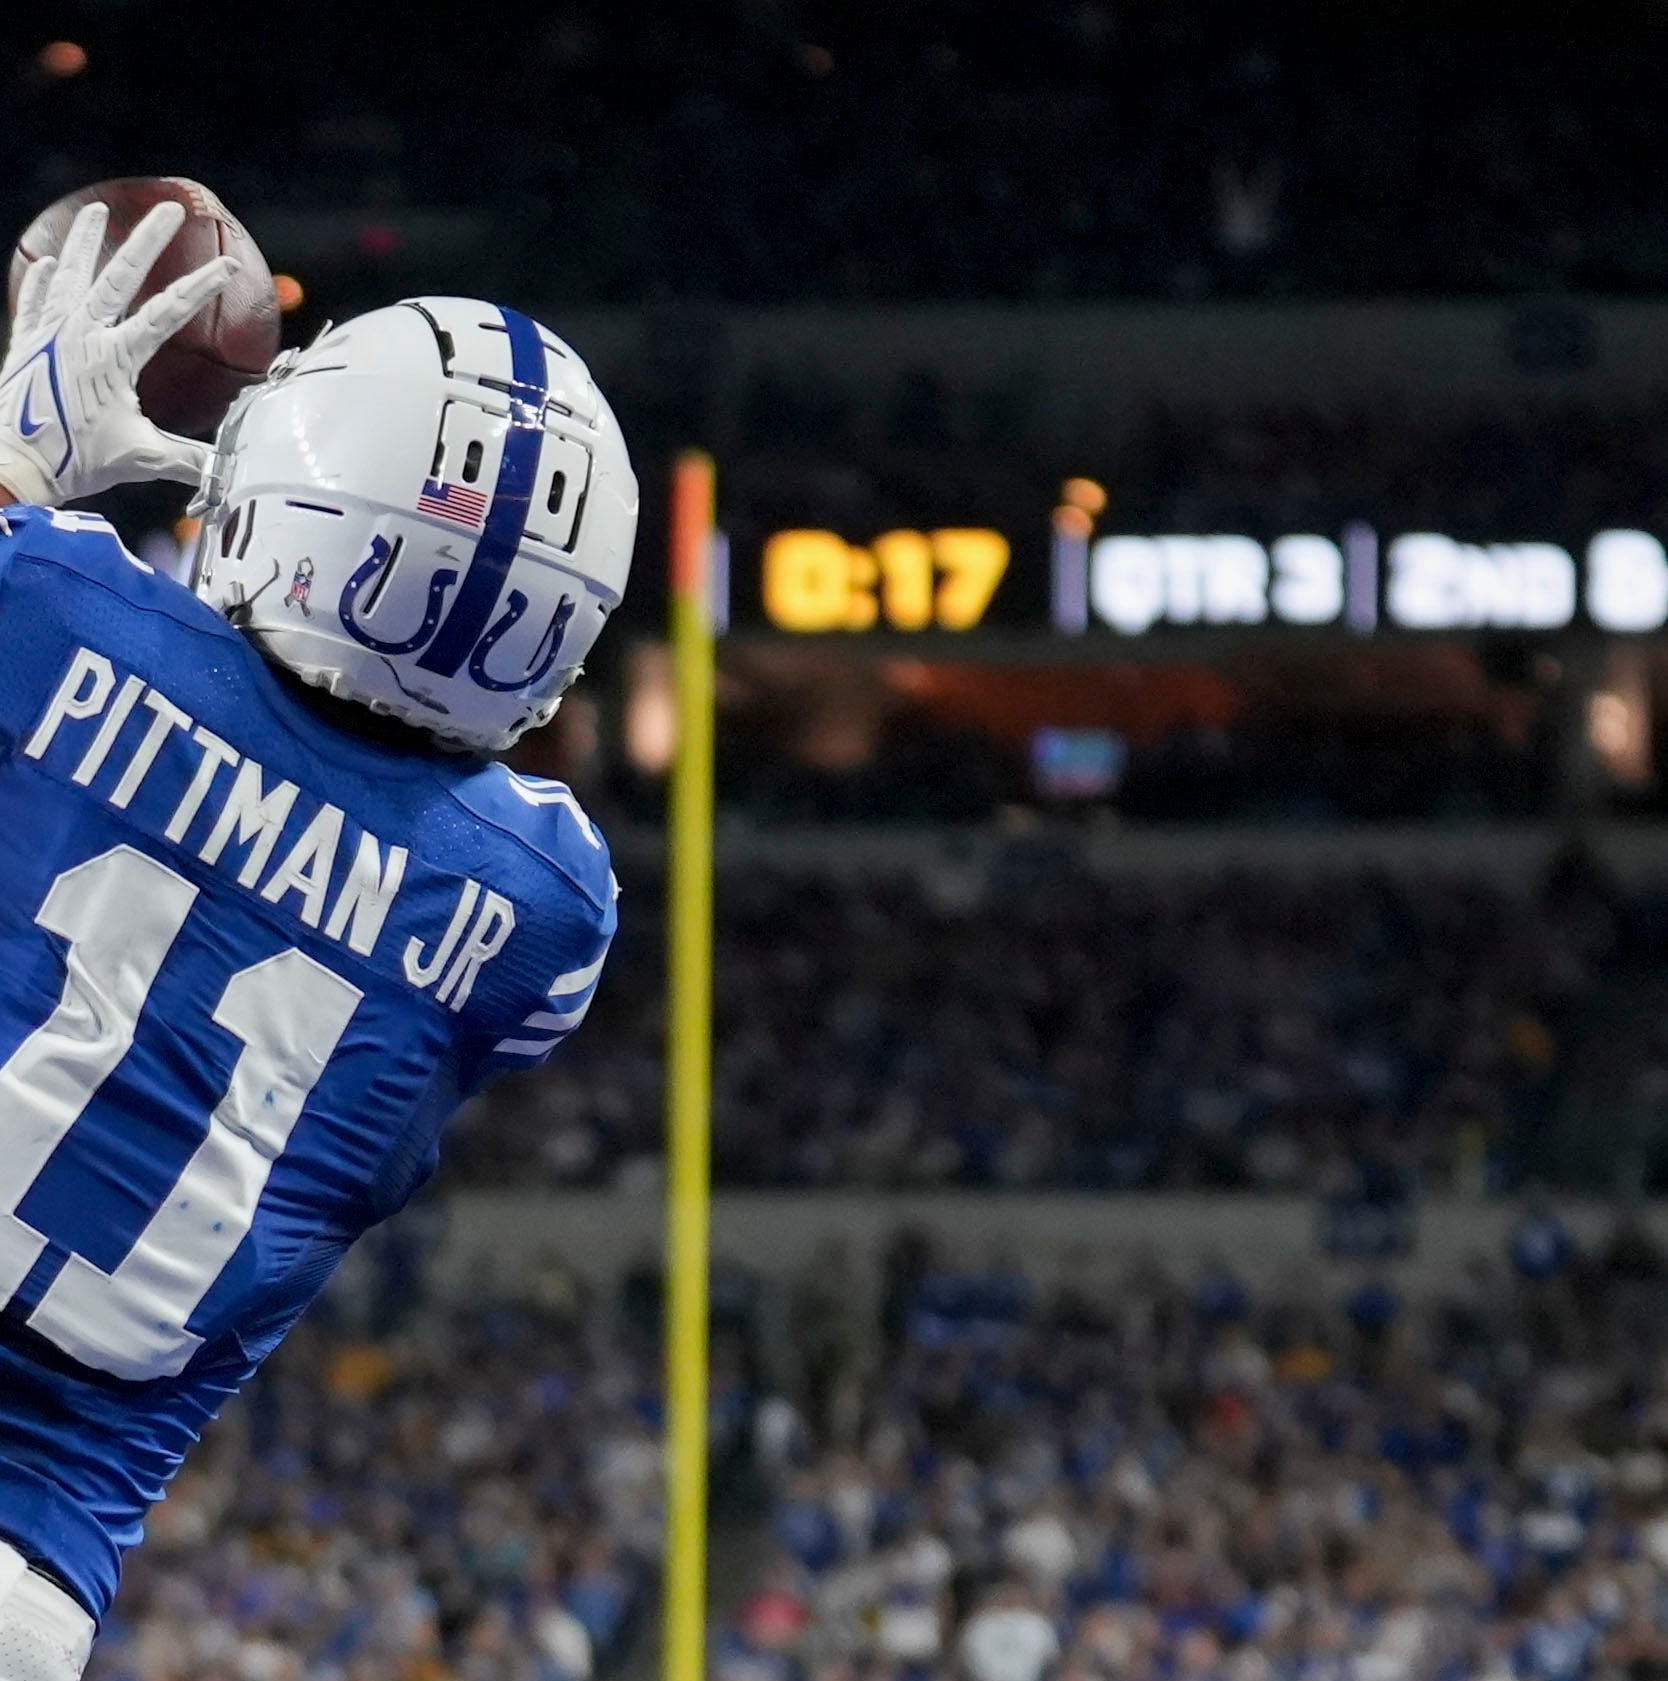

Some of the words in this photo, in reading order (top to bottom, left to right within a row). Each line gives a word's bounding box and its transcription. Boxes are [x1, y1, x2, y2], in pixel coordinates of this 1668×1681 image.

[763, 528, 1010, 633] 0:17
[1089, 535, 1266, 636] QTR
[1270, 534, 1343, 624] 3
[1386, 532, 1576, 630] 2ND
[24, 647, 407, 958] PITTMAN
[402, 878, 516, 1013] JR
